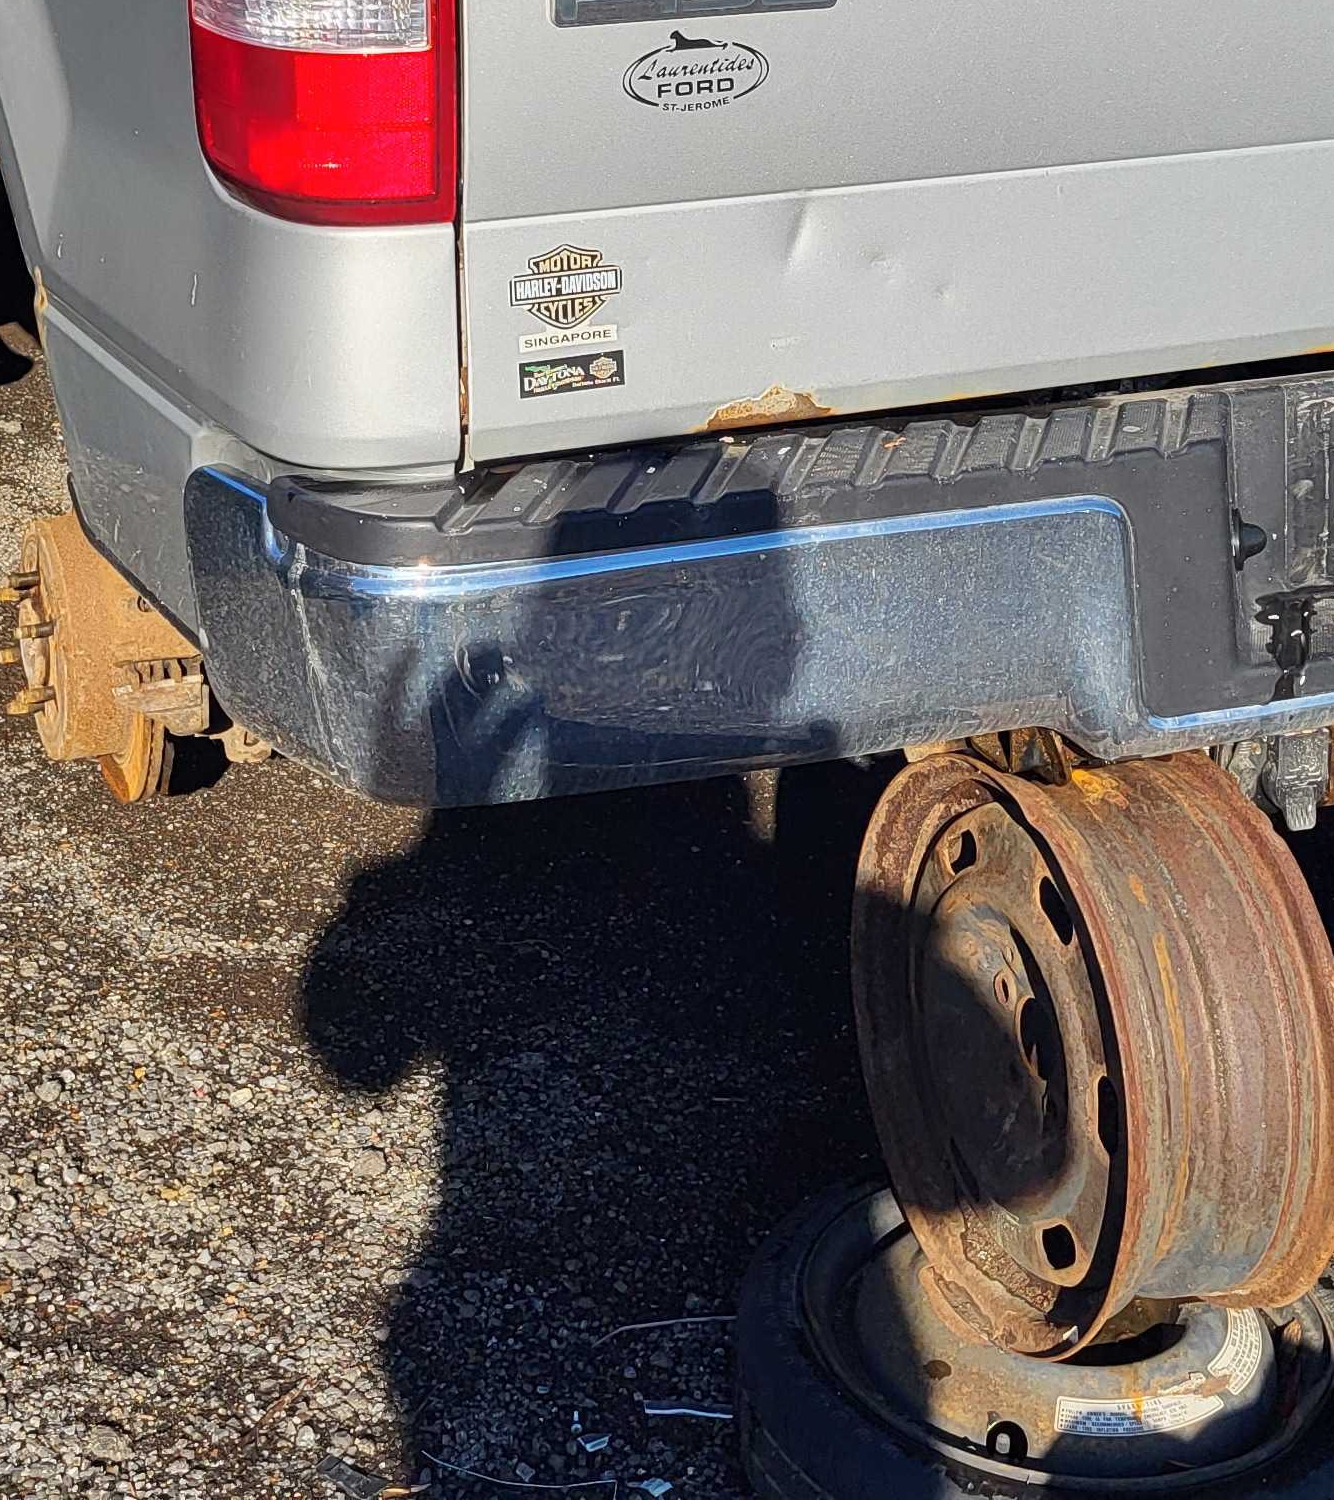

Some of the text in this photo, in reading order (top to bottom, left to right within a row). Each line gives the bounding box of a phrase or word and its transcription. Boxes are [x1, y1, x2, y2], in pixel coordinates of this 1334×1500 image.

[637, 54, 755, 81] Laurentides
[657, 77, 735, 98] FORD
[662, 96, 730, 112] ST-JEROME
[539, 253, 592, 274] MOTOR
[516, 269, 618, 300] HARLEY-DAVIDSON
[540, 298, 596, 322] CYCLES
[524, 329, 612, 349] SINGAPORE
[523, 366, 586, 392] DAYTONA
